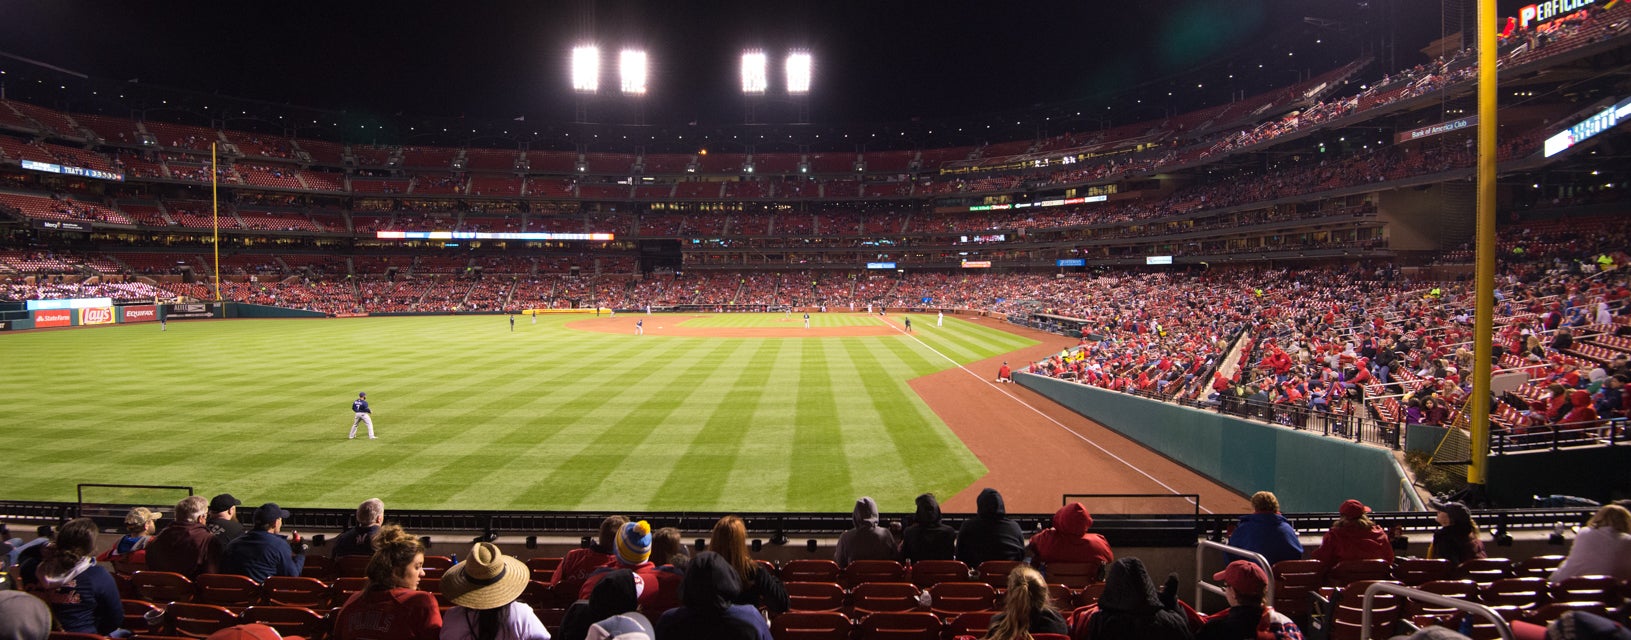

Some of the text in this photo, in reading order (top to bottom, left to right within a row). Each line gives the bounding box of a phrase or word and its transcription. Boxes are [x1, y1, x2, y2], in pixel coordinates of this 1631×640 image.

[1432, 124, 1453, 133] America
[1454, 120, 1467, 128] Club
[126, 310, 154, 318] EQUIFAX
